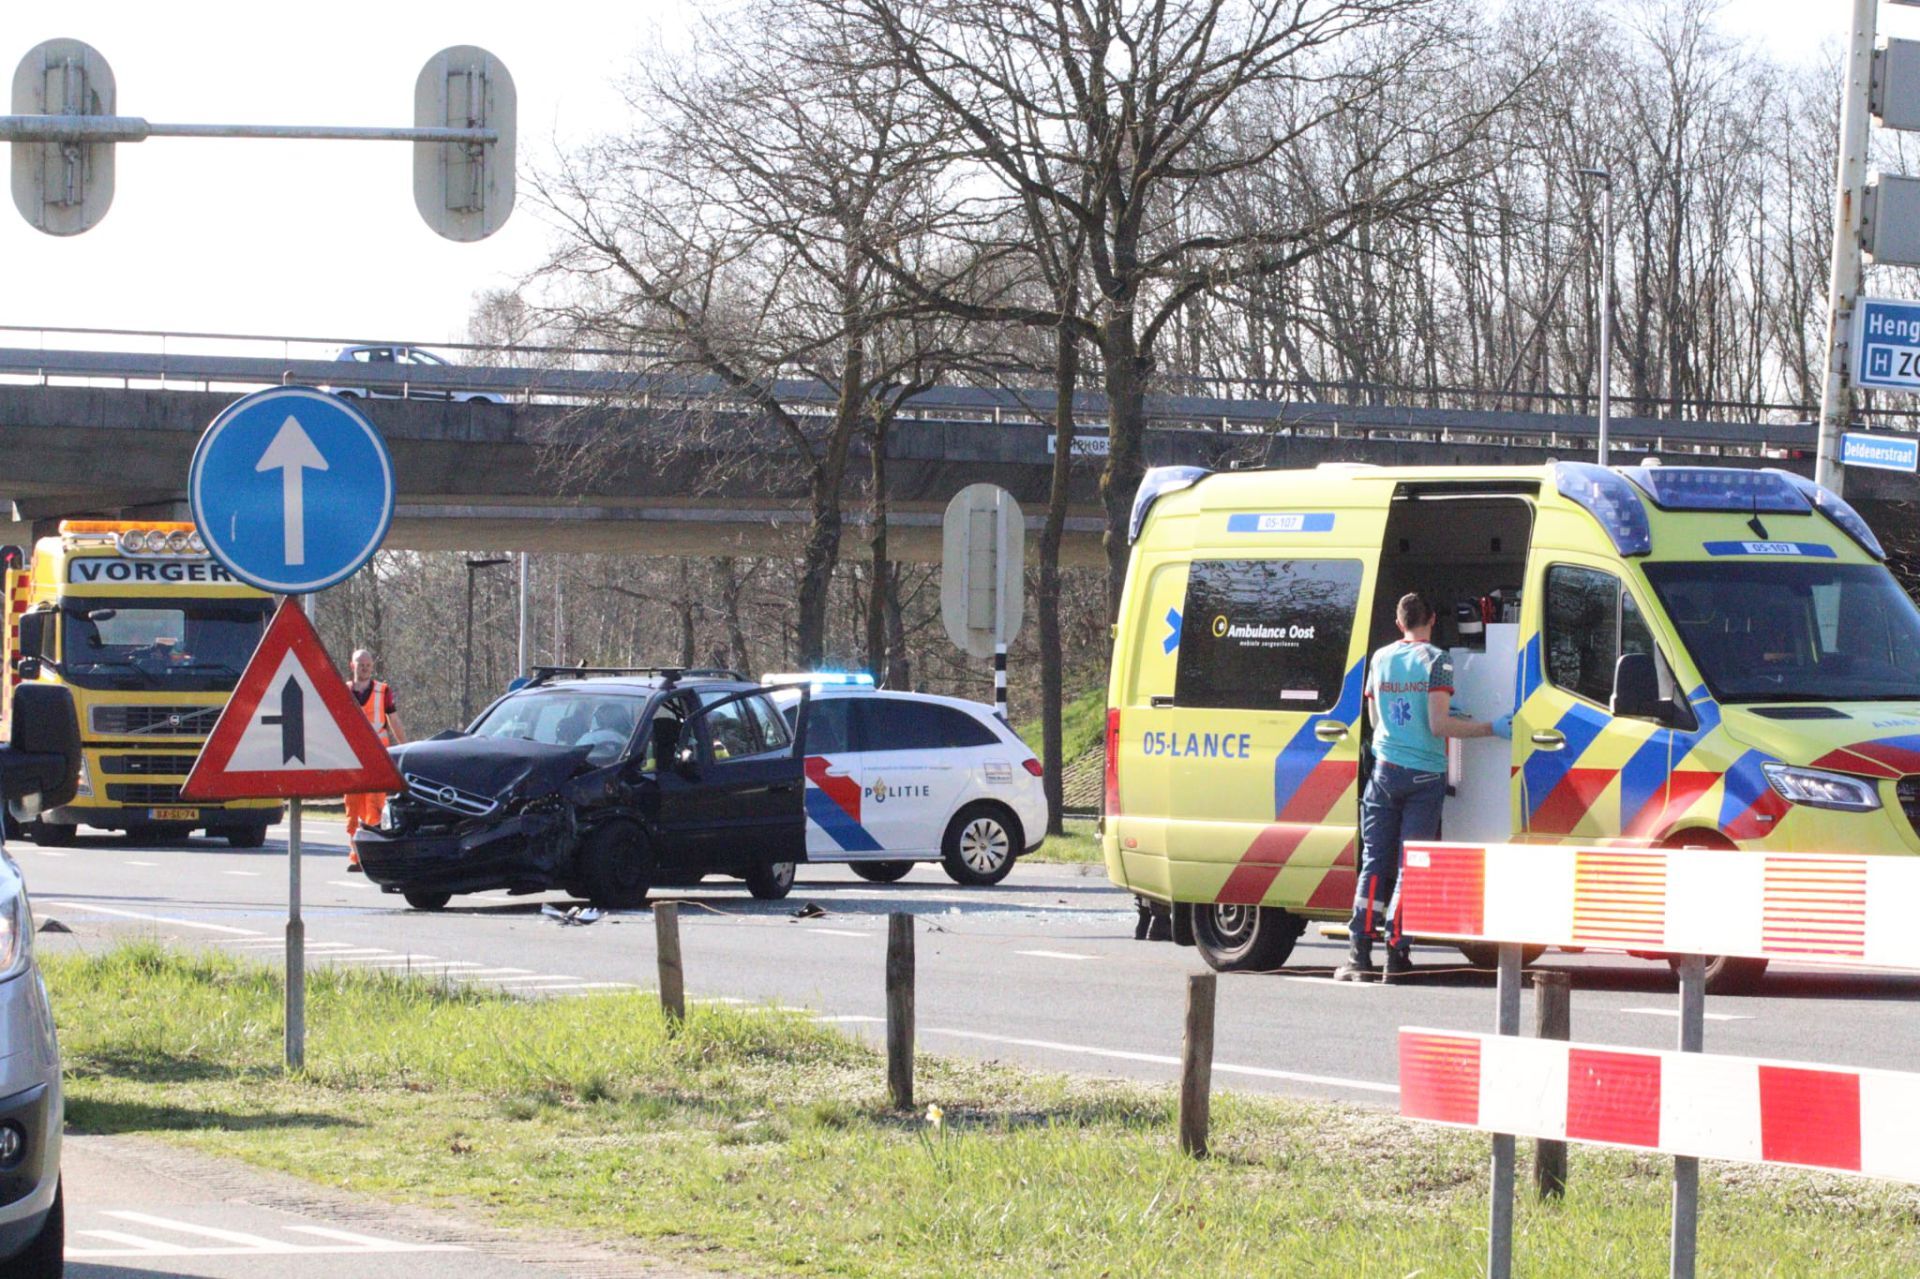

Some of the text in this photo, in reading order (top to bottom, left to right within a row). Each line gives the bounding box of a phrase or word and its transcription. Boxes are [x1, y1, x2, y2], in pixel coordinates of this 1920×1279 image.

[1845, 442, 1913, 463] Deldenerstraat
[1752, 543, 1791, 553] 05-107
[78, 563, 242, 582] VORGER
[1227, 624, 1315, 639] Ambulance Oost
